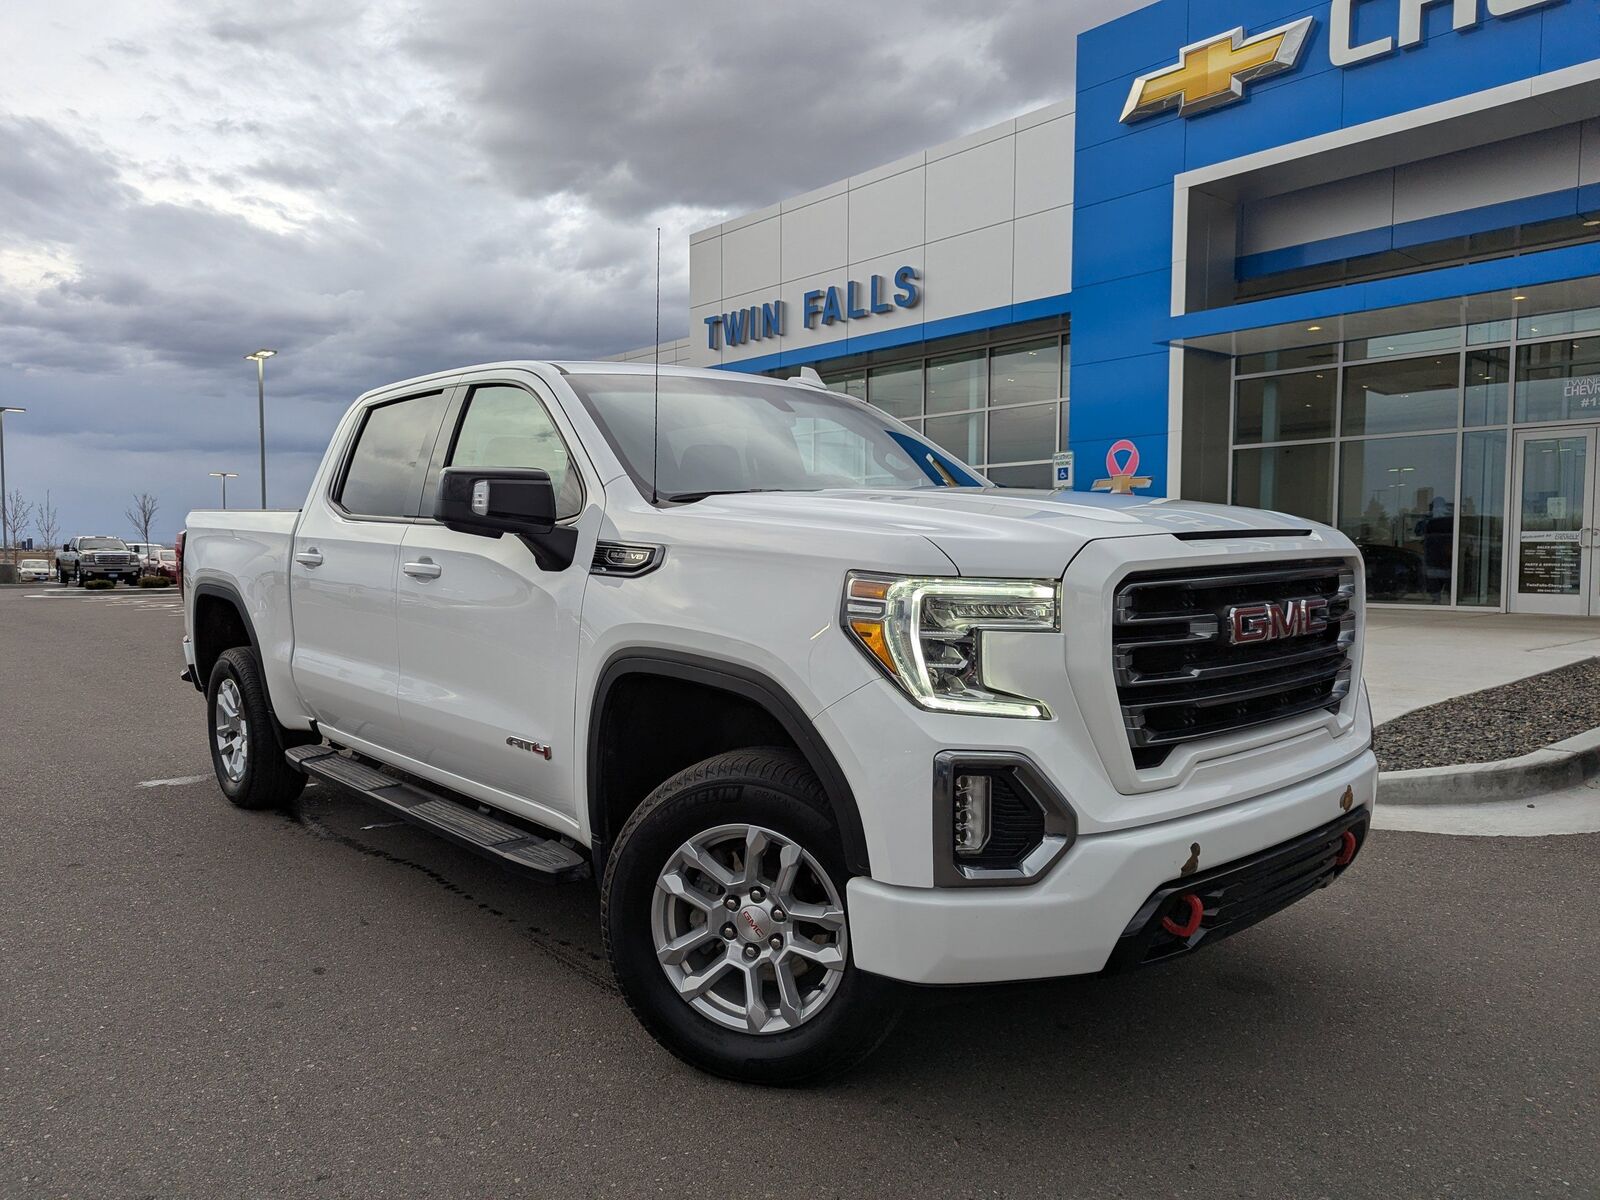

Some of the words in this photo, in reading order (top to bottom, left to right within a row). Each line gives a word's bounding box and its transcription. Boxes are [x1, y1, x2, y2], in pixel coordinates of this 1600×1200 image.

[704, 300, 784, 350] TWIN
[804, 266, 920, 329] FALLS
[1230, 600, 1328, 645] GMC
[506, 735, 552, 760] AT4
[742, 911, 765, 938] GMC
